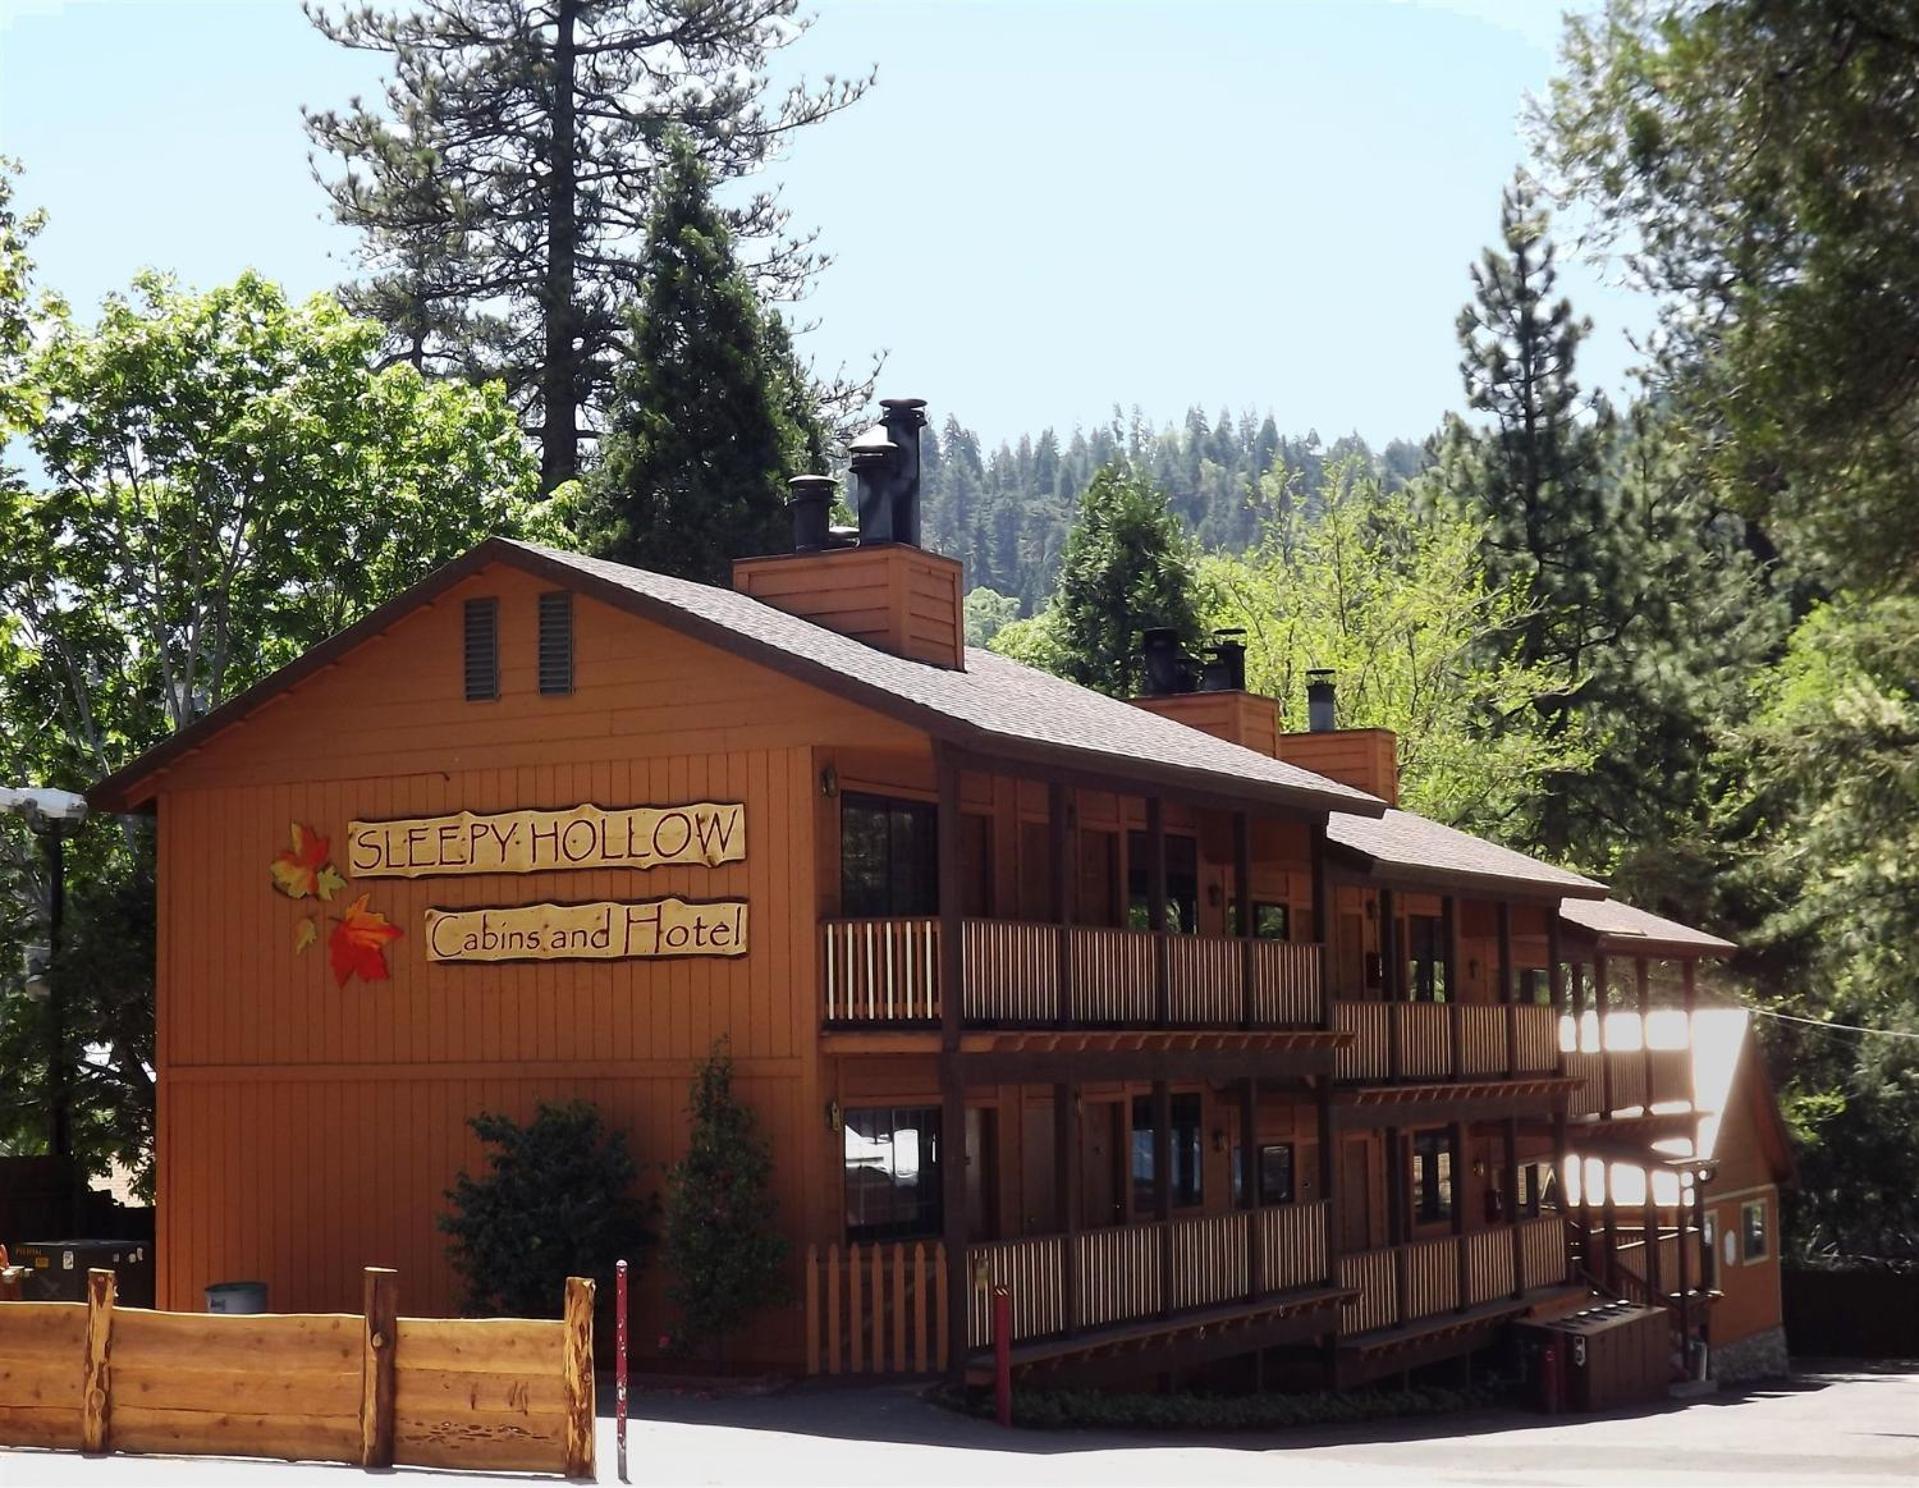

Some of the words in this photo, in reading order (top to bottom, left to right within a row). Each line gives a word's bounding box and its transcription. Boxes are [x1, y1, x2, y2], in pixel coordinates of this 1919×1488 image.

[353, 822, 518, 870] SLEEPY
[531, 809, 738, 863] HOLLOW
[431, 912, 541, 958] Cabins
[552, 907, 611, 949] and
[624, 904, 742, 954] Hotel
